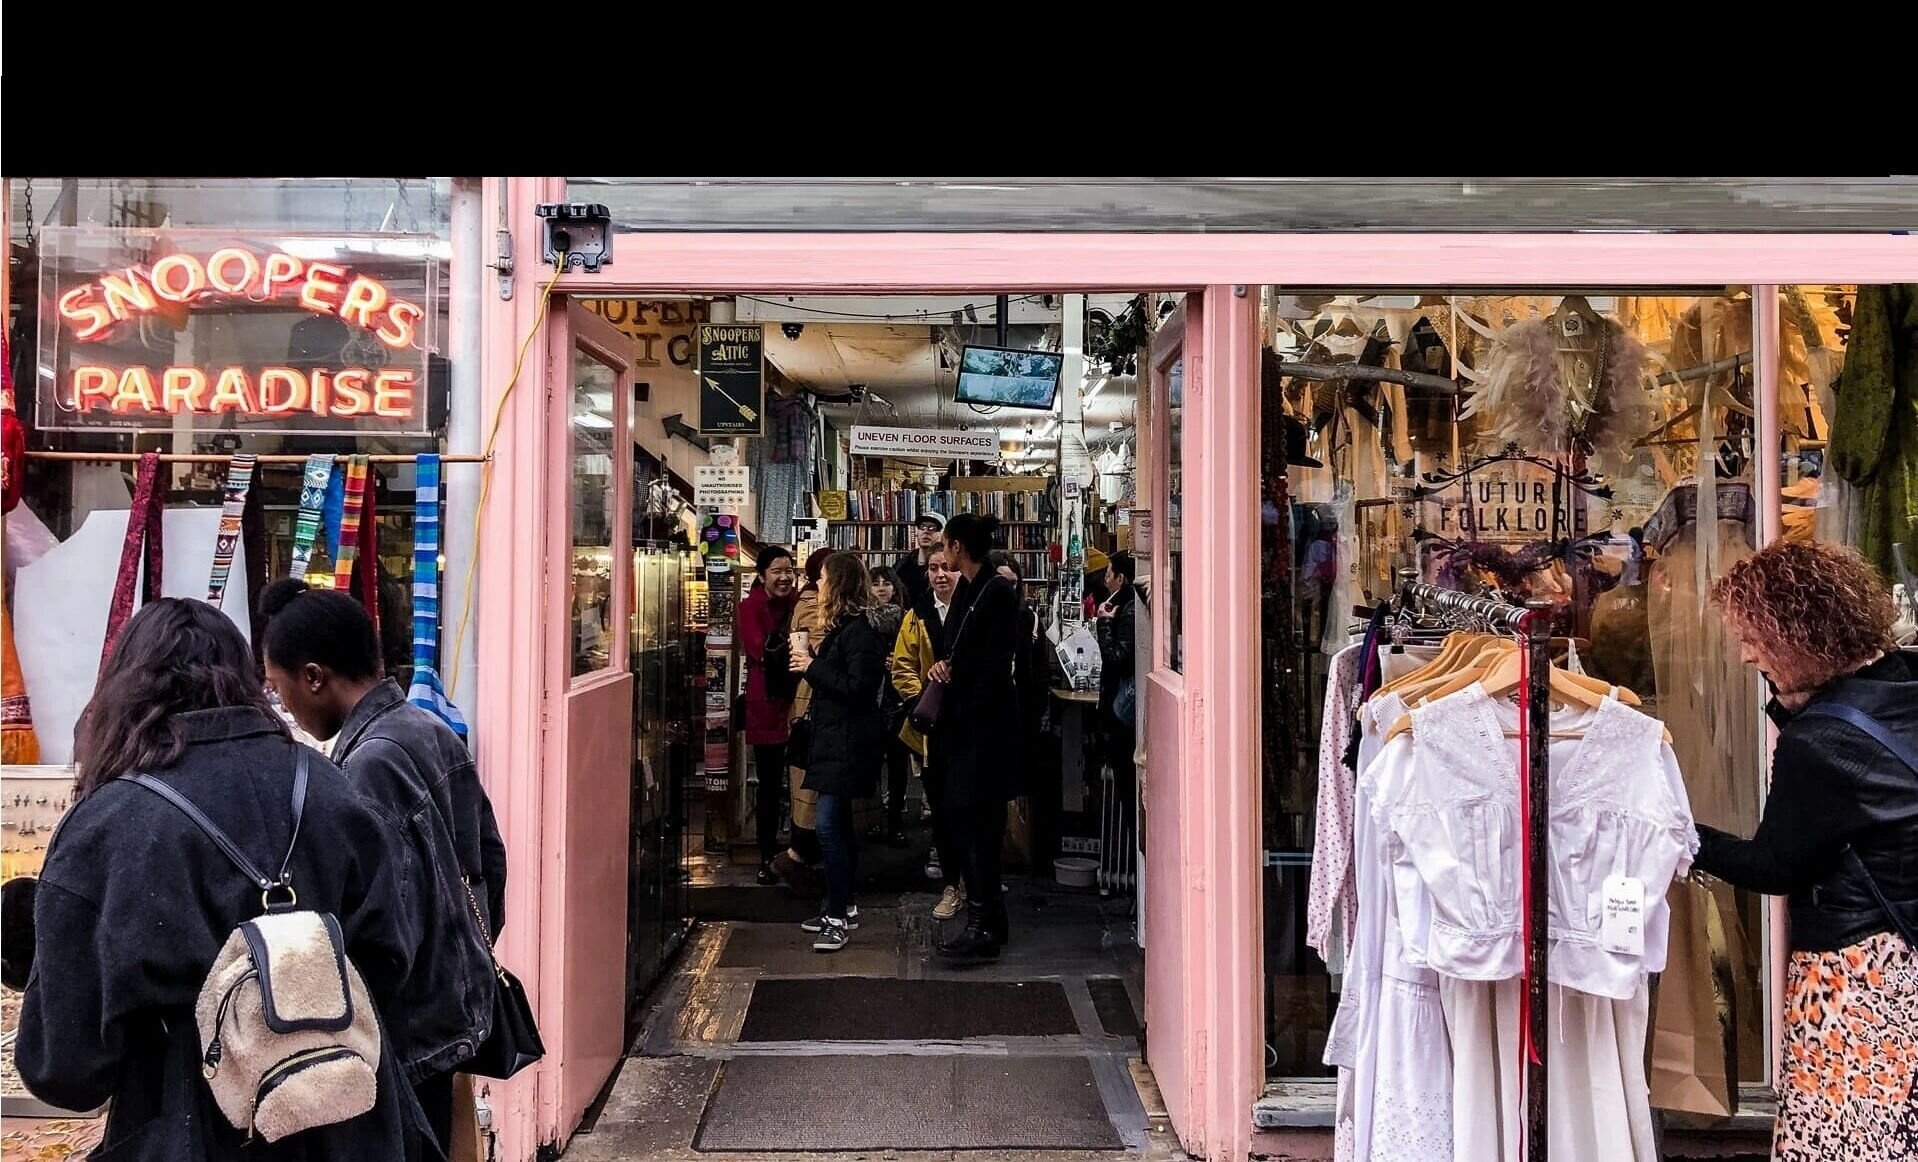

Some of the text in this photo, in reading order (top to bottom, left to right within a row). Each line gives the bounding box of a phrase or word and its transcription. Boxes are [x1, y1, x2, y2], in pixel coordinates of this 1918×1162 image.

[58, 246, 424, 349] SNOOPERS
[702, 326, 761, 345] SNOOPERS
[73, 365, 414, 418] PARADISE
[858, 431, 992, 447] UNEVEN FLOOR SURFACES
[1441, 507, 1587, 532] FOLKLORE
